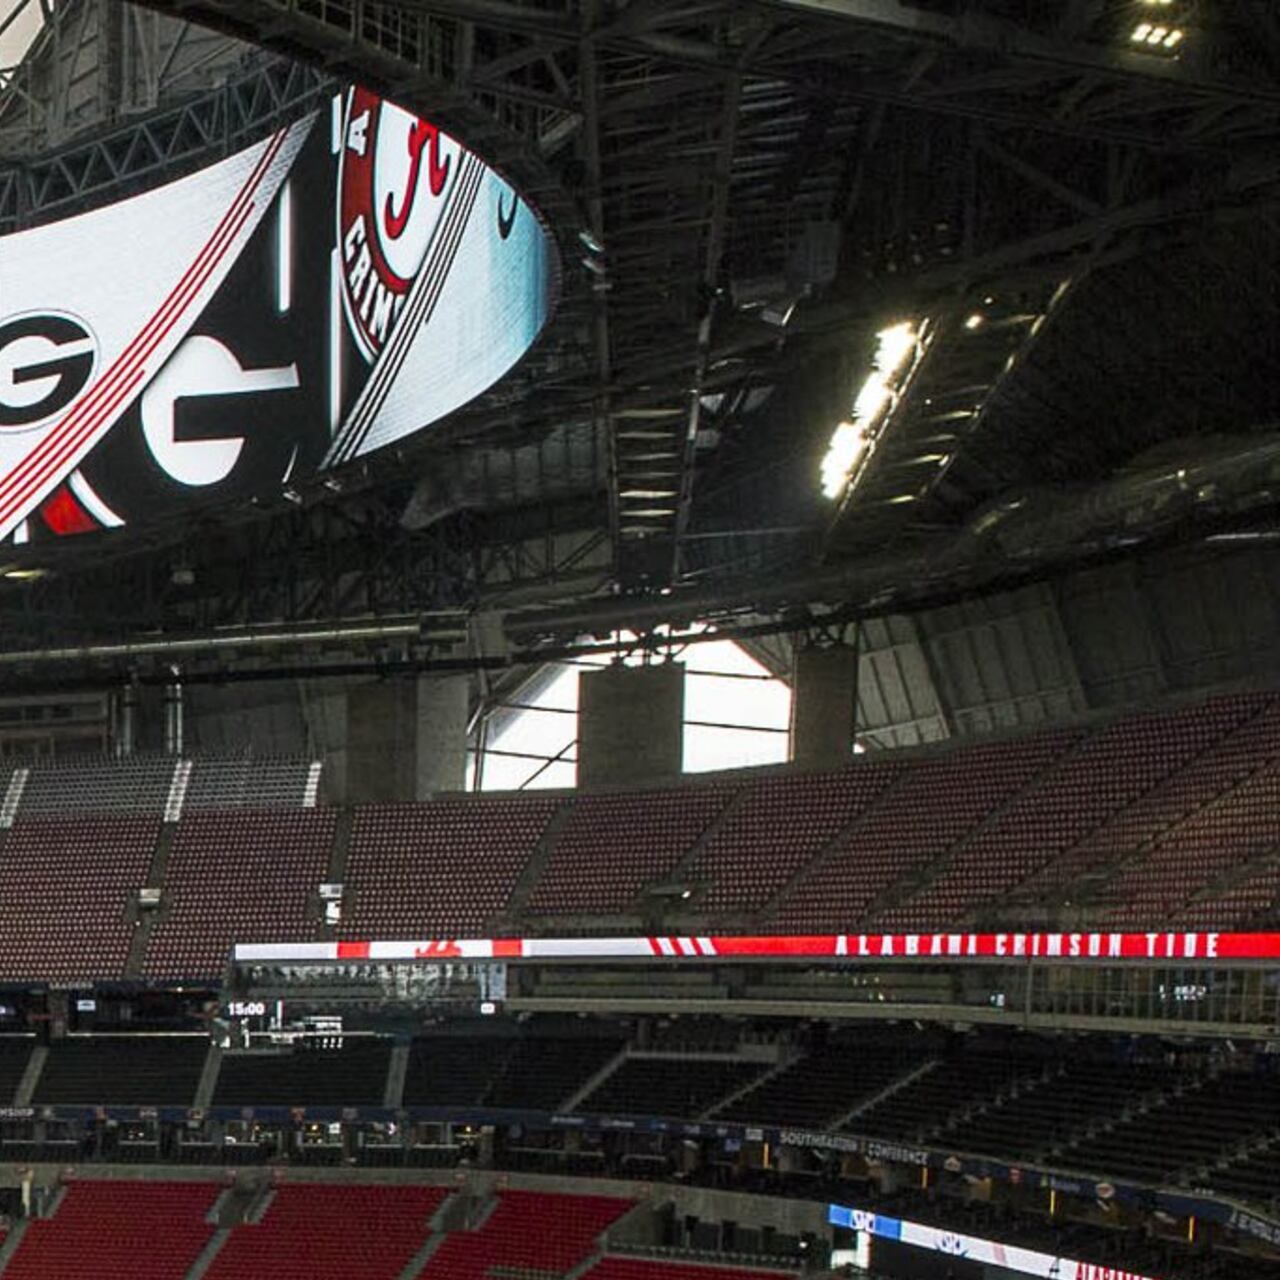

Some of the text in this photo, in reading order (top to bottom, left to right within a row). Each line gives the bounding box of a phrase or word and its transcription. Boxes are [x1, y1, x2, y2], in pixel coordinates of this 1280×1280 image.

[835, 934, 1218, 957] ALABAMA CRIMSON TIDE
[227, 1002, 265, 1016] 15:00
[779, 1129, 929, 1165] SOUTHEASTERN CONFERENCE
